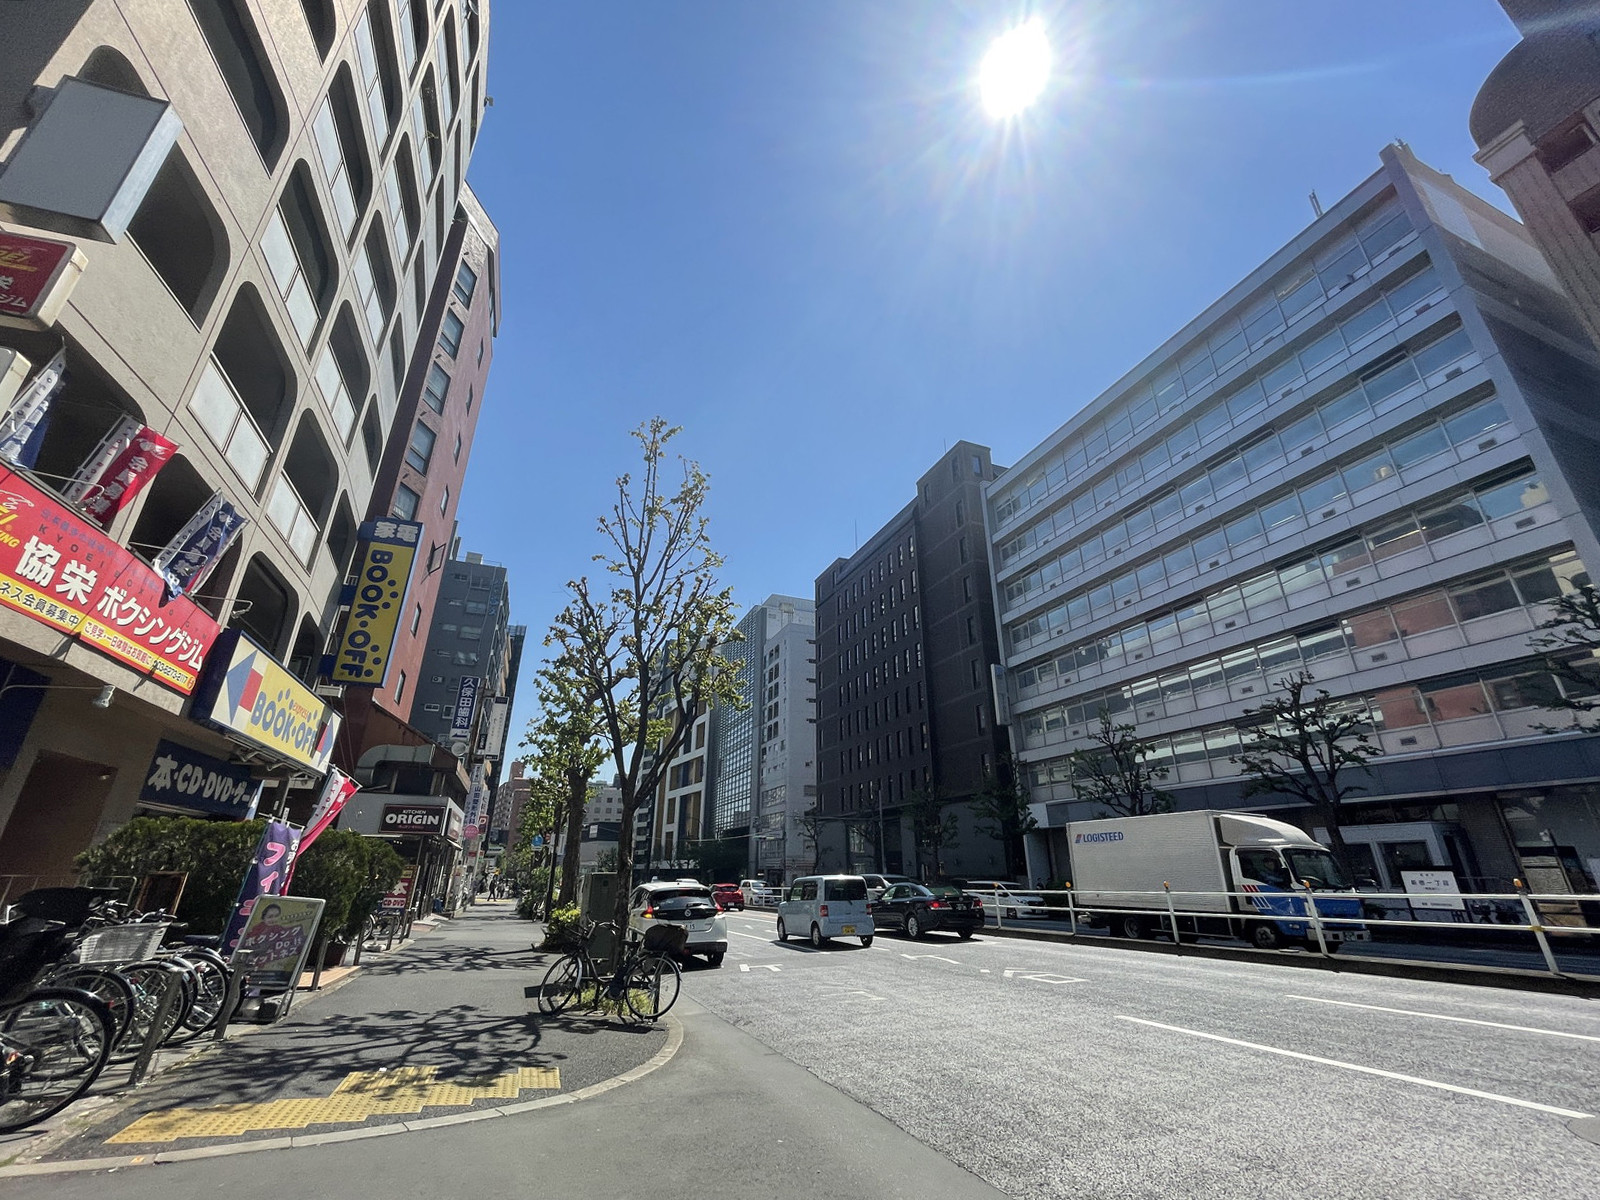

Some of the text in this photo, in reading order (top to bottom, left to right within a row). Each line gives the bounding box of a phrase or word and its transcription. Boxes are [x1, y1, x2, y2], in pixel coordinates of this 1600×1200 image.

[374, 521, 418, 543] 家電
[14, 534, 98, 606] 協栄
[96, 585, 204, 672] ボクシングジム
[455, 677, 476, 728] 久保田歯科
[385, 812, 440, 825] ORIGIN
[1083, 831, 1124, 843] LOGISTEED
